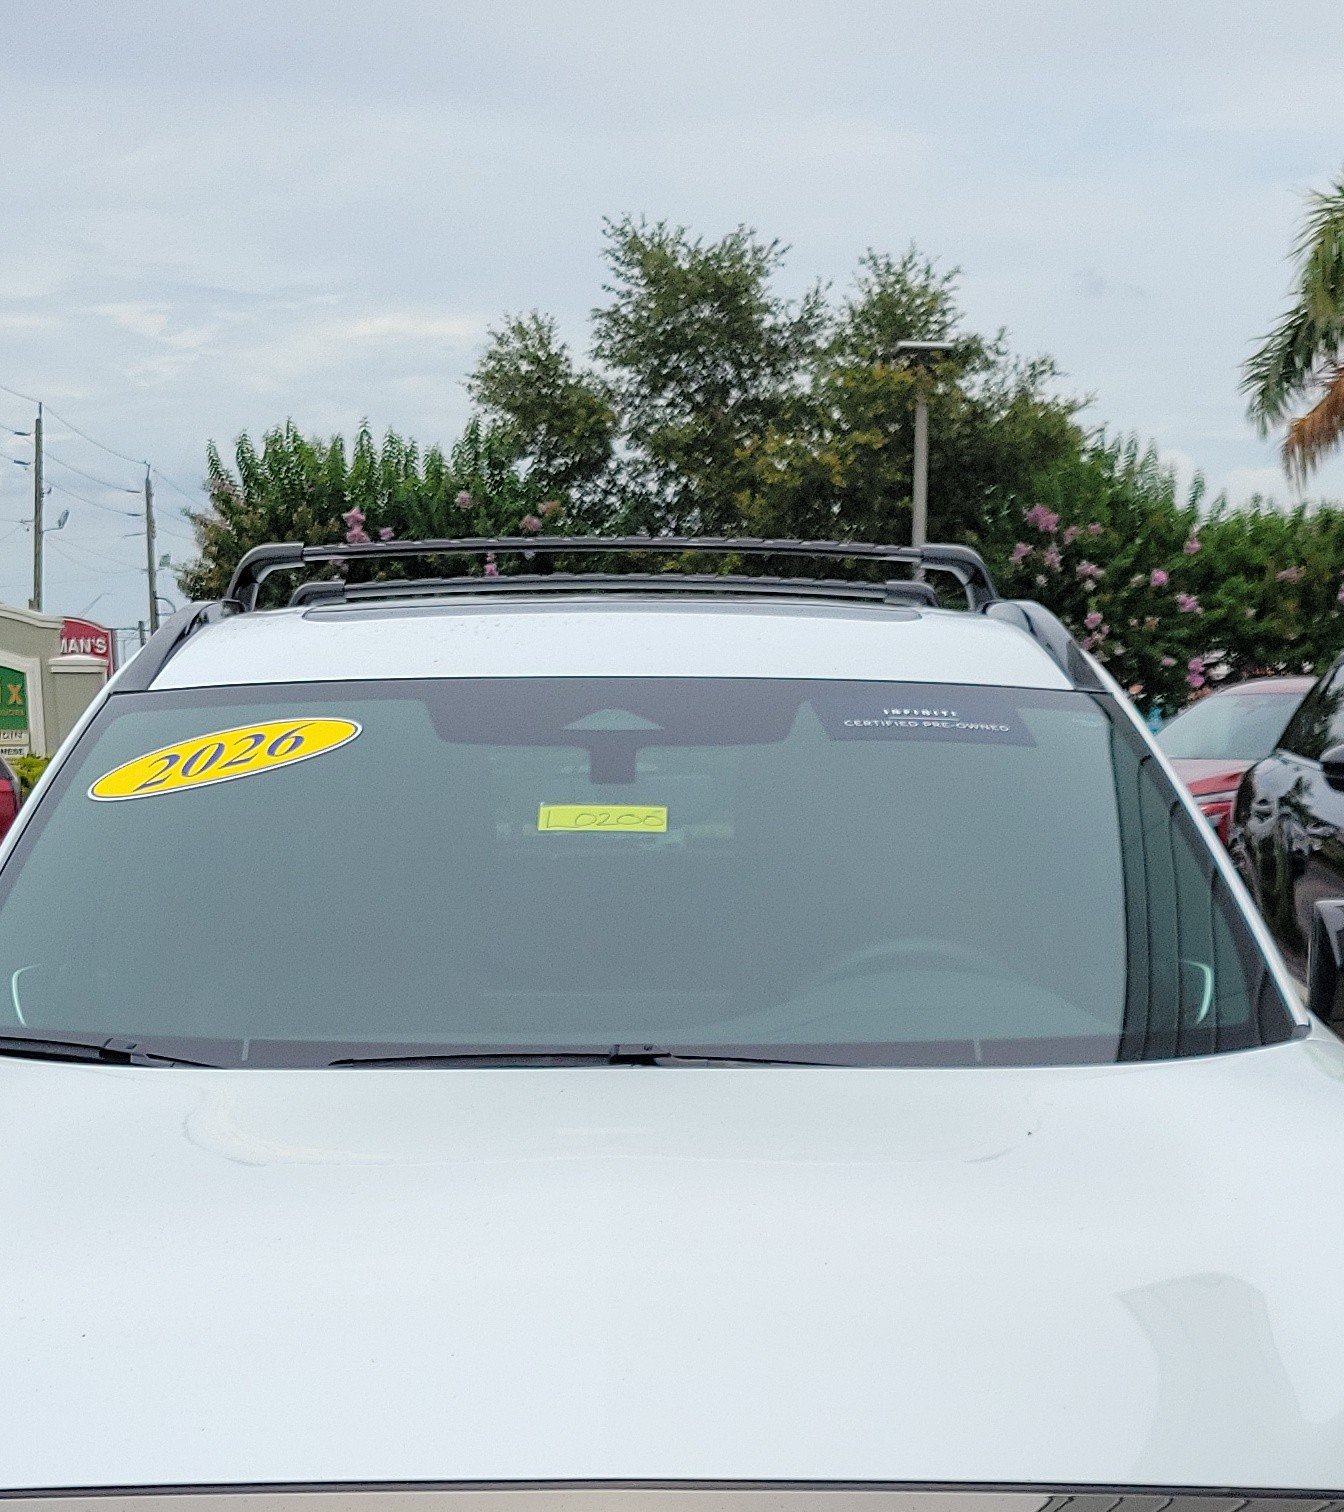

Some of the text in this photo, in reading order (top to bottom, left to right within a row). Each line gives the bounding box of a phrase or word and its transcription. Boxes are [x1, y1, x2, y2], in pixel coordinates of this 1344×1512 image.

[843, 719, 1010, 732] CERTIFIED PRE-OWNED
[132, 722, 316, 792] 2026
